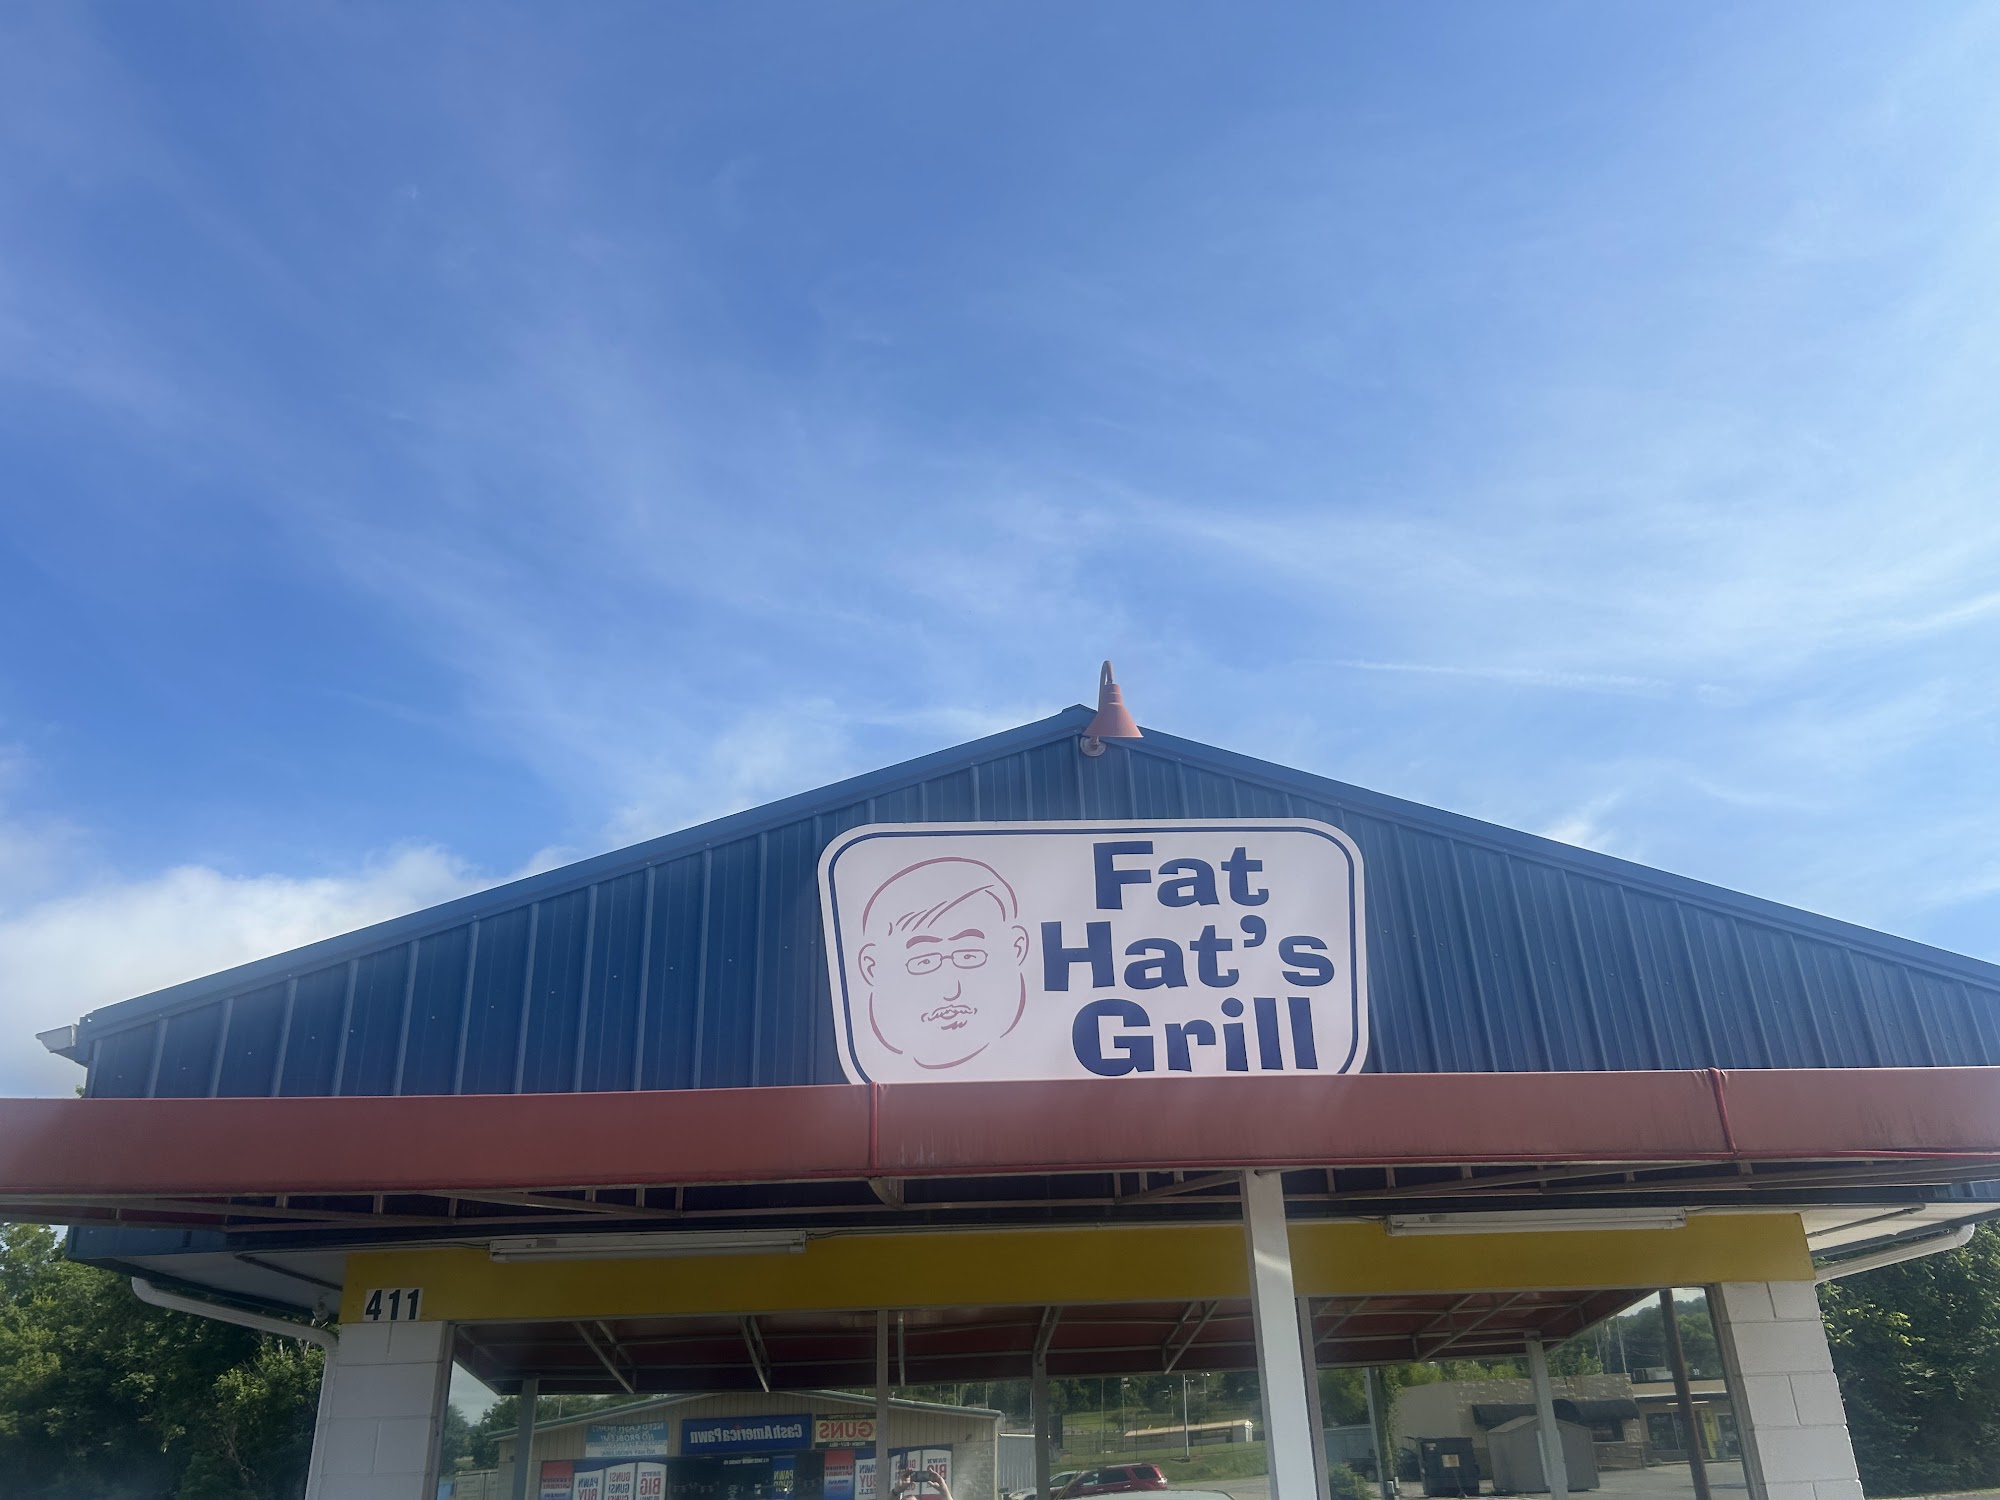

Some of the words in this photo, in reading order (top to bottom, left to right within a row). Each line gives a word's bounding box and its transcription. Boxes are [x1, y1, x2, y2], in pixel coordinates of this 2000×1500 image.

[1093, 840, 1269, 910] Fat
[1040, 914, 1335, 992] Hat's
[1072, 997, 1319, 1077] Grill
[365, 1288, 420, 1321] 411
